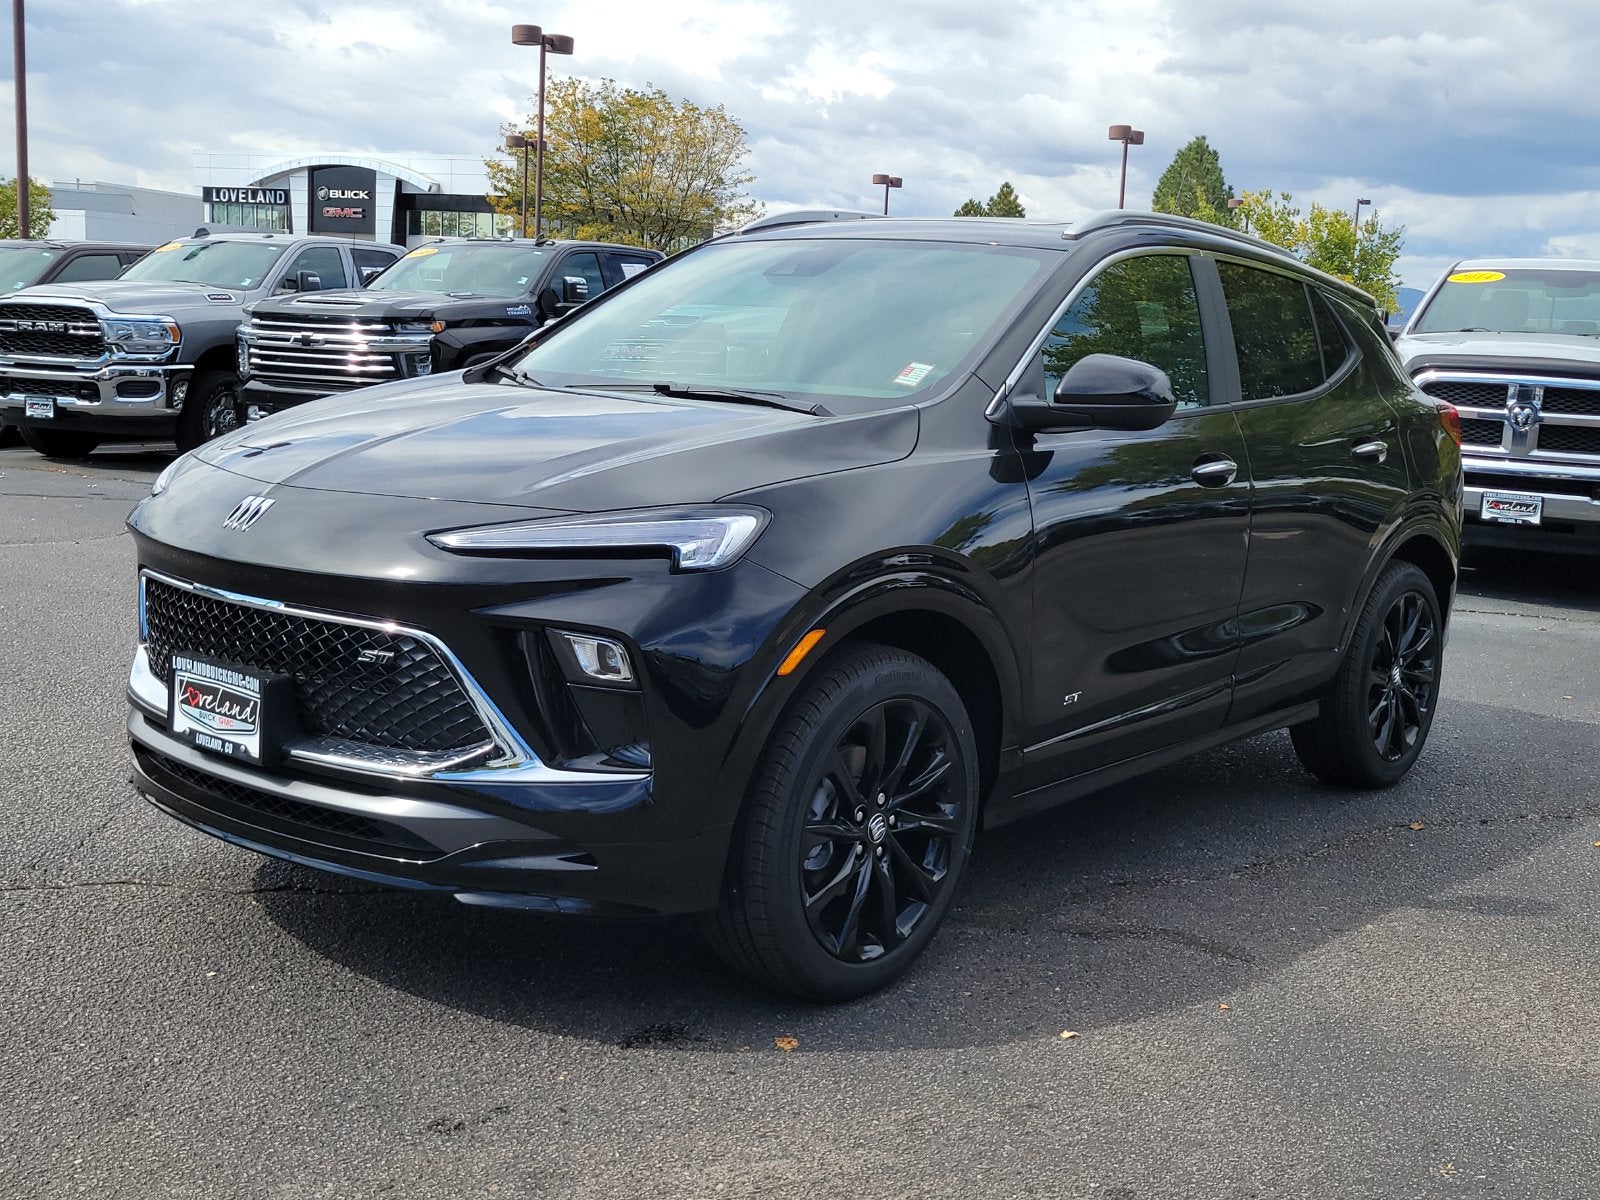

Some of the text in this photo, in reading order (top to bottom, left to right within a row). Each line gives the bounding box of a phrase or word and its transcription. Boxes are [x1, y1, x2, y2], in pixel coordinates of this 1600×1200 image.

[212, 188, 285, 204] LOVELAND
[329, 189, 370, 200] BUICK
[323, 207, 363, 218] GMC
[18, 321, 65, 332] RAM
[357, 649, 394, 664] ST
[218, 716, 234, 727] GMC
